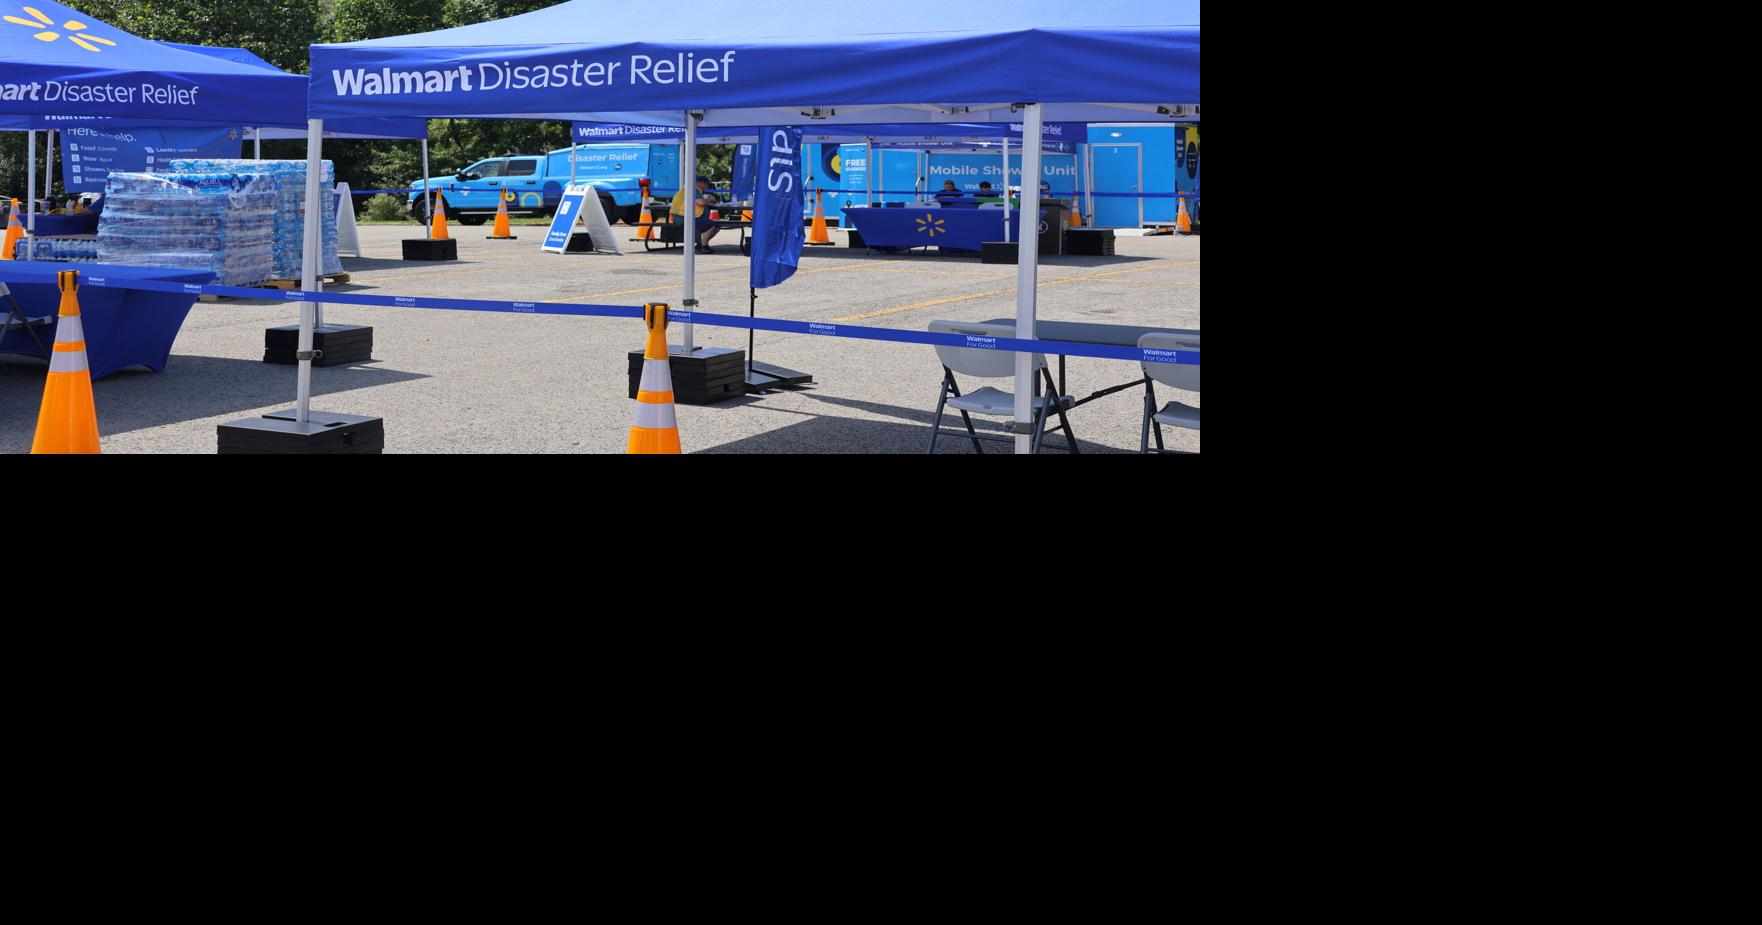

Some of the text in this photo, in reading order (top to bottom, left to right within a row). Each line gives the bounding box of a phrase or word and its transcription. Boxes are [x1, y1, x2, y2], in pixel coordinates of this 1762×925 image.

[333, 50, 735, 95] Walmart Disaster Relief
[0, 81, 200, 106] art Disaster Relief
[579, 125, 623, 137] Walmart
[624, 125, 665, 135] Disaster
[609, 152, 638, 161] Relief
[845, 159, 867, 167] FREE
[930, 165, 977, 176] Mobile
[1044, 165, 1077, 176] Unit
[809, 323, 836, 331] Walmart
[966, 336, 996, 344] Walmart
[1143, 348, 1177, 357] Walmart
